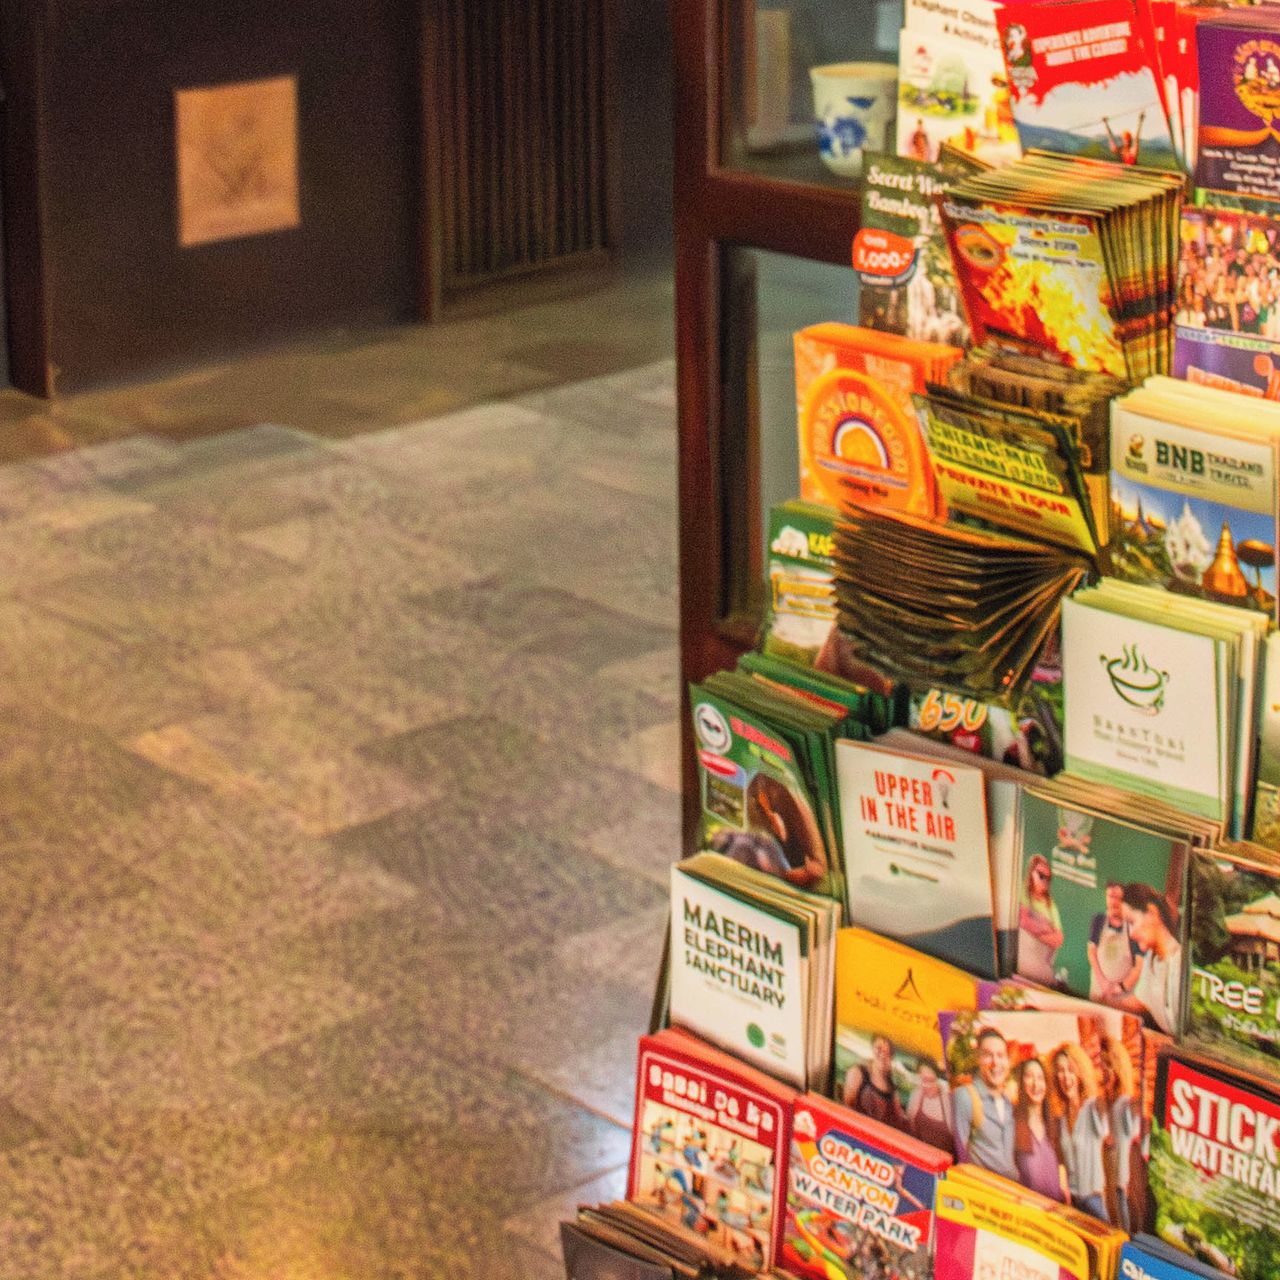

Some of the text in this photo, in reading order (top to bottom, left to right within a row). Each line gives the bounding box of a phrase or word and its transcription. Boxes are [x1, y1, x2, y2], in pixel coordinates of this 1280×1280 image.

[867, 165, 915, 190] Secret
[1154, 439, 1207, 478] BNB
[1019, 488, 1072, 518] TOUR
[873, 770, 933, 807] UPPER
[859, 794, 957, 843] IN THE AIR
[682, 896, 785, 968] MAERIM
[683, 927, 786, 991] ELEPHANT
[684, 949, 786, 1010] SANCTUARY
[1193, 968, 1263, 1014] TREE
[818, 1134, 894, 1185] GRAND
[793, 1172, 920, 1250] WATER PARK
[811, 1159, 899, 1215] CANYON
